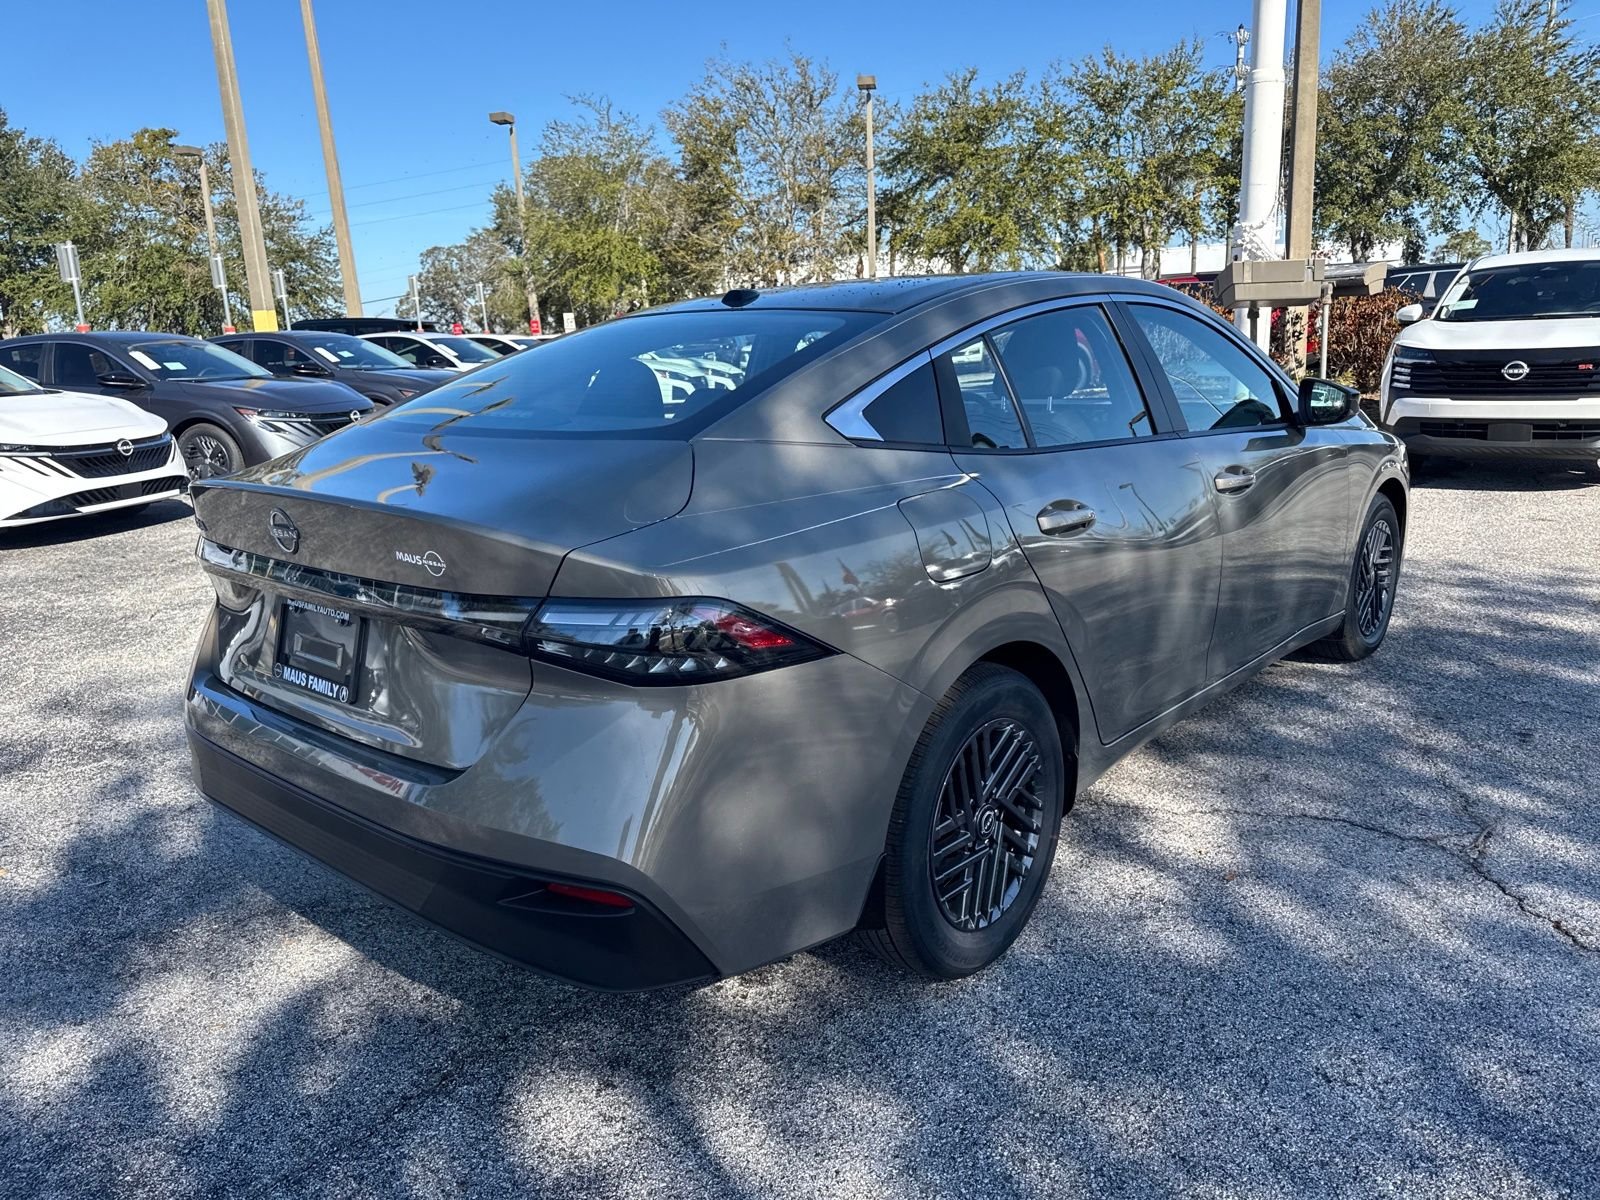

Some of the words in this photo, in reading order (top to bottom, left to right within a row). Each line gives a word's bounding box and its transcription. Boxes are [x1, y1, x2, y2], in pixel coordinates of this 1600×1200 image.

[395, 550, 422, 565] MAUS
[422, 559, 446, 568] NISSAN
[283, 666, 307, 687] MAUS
[307, 674, 340, 698] FAMILY
